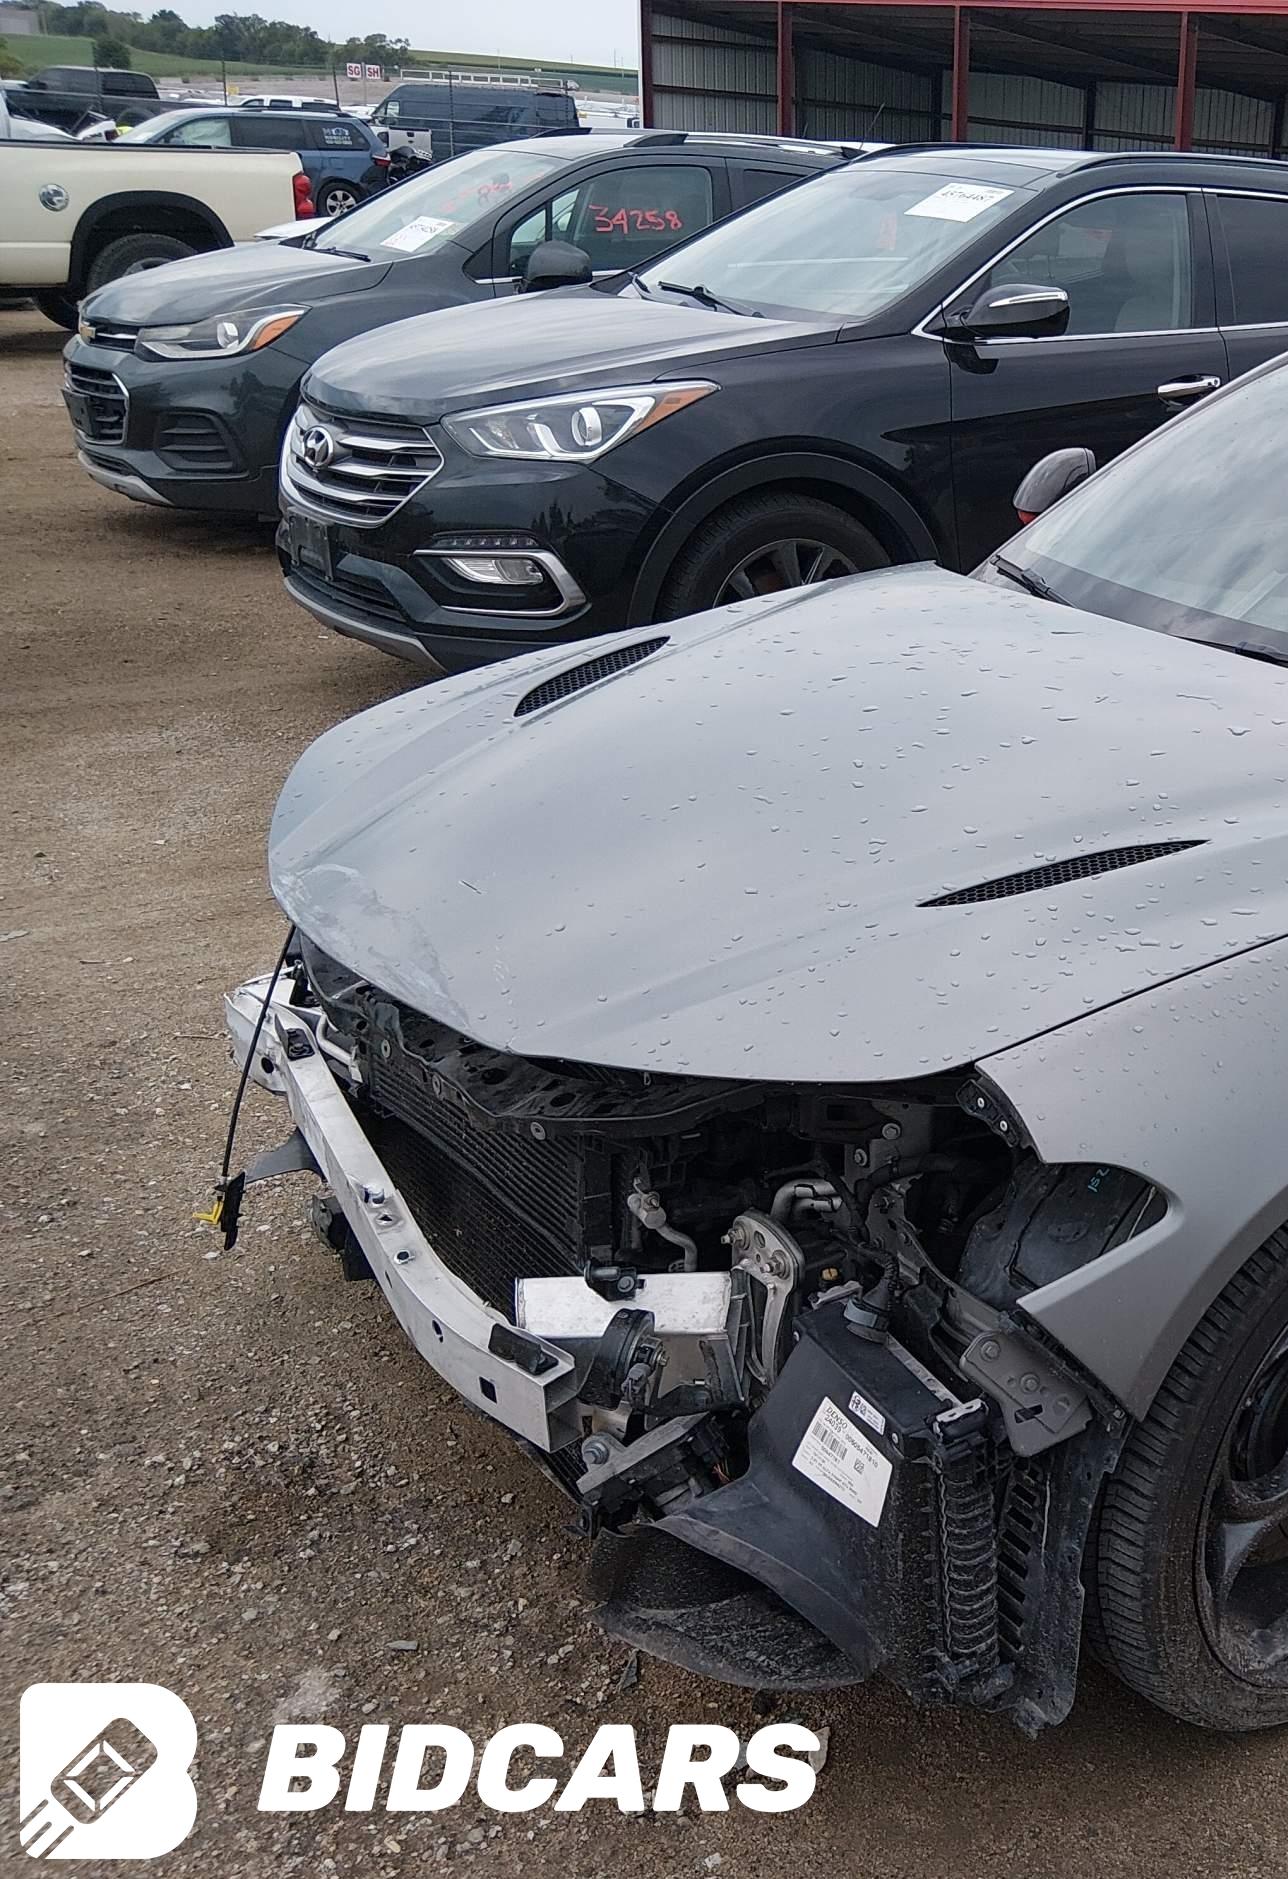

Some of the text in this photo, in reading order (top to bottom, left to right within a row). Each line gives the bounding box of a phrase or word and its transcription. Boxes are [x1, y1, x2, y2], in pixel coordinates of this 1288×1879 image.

[347, 65, 360, 76] SG
[367, 67, 379, 78] SH
[588, 204, 683, 235] 34258
[826, 1406, 848, 1430] DENSO
